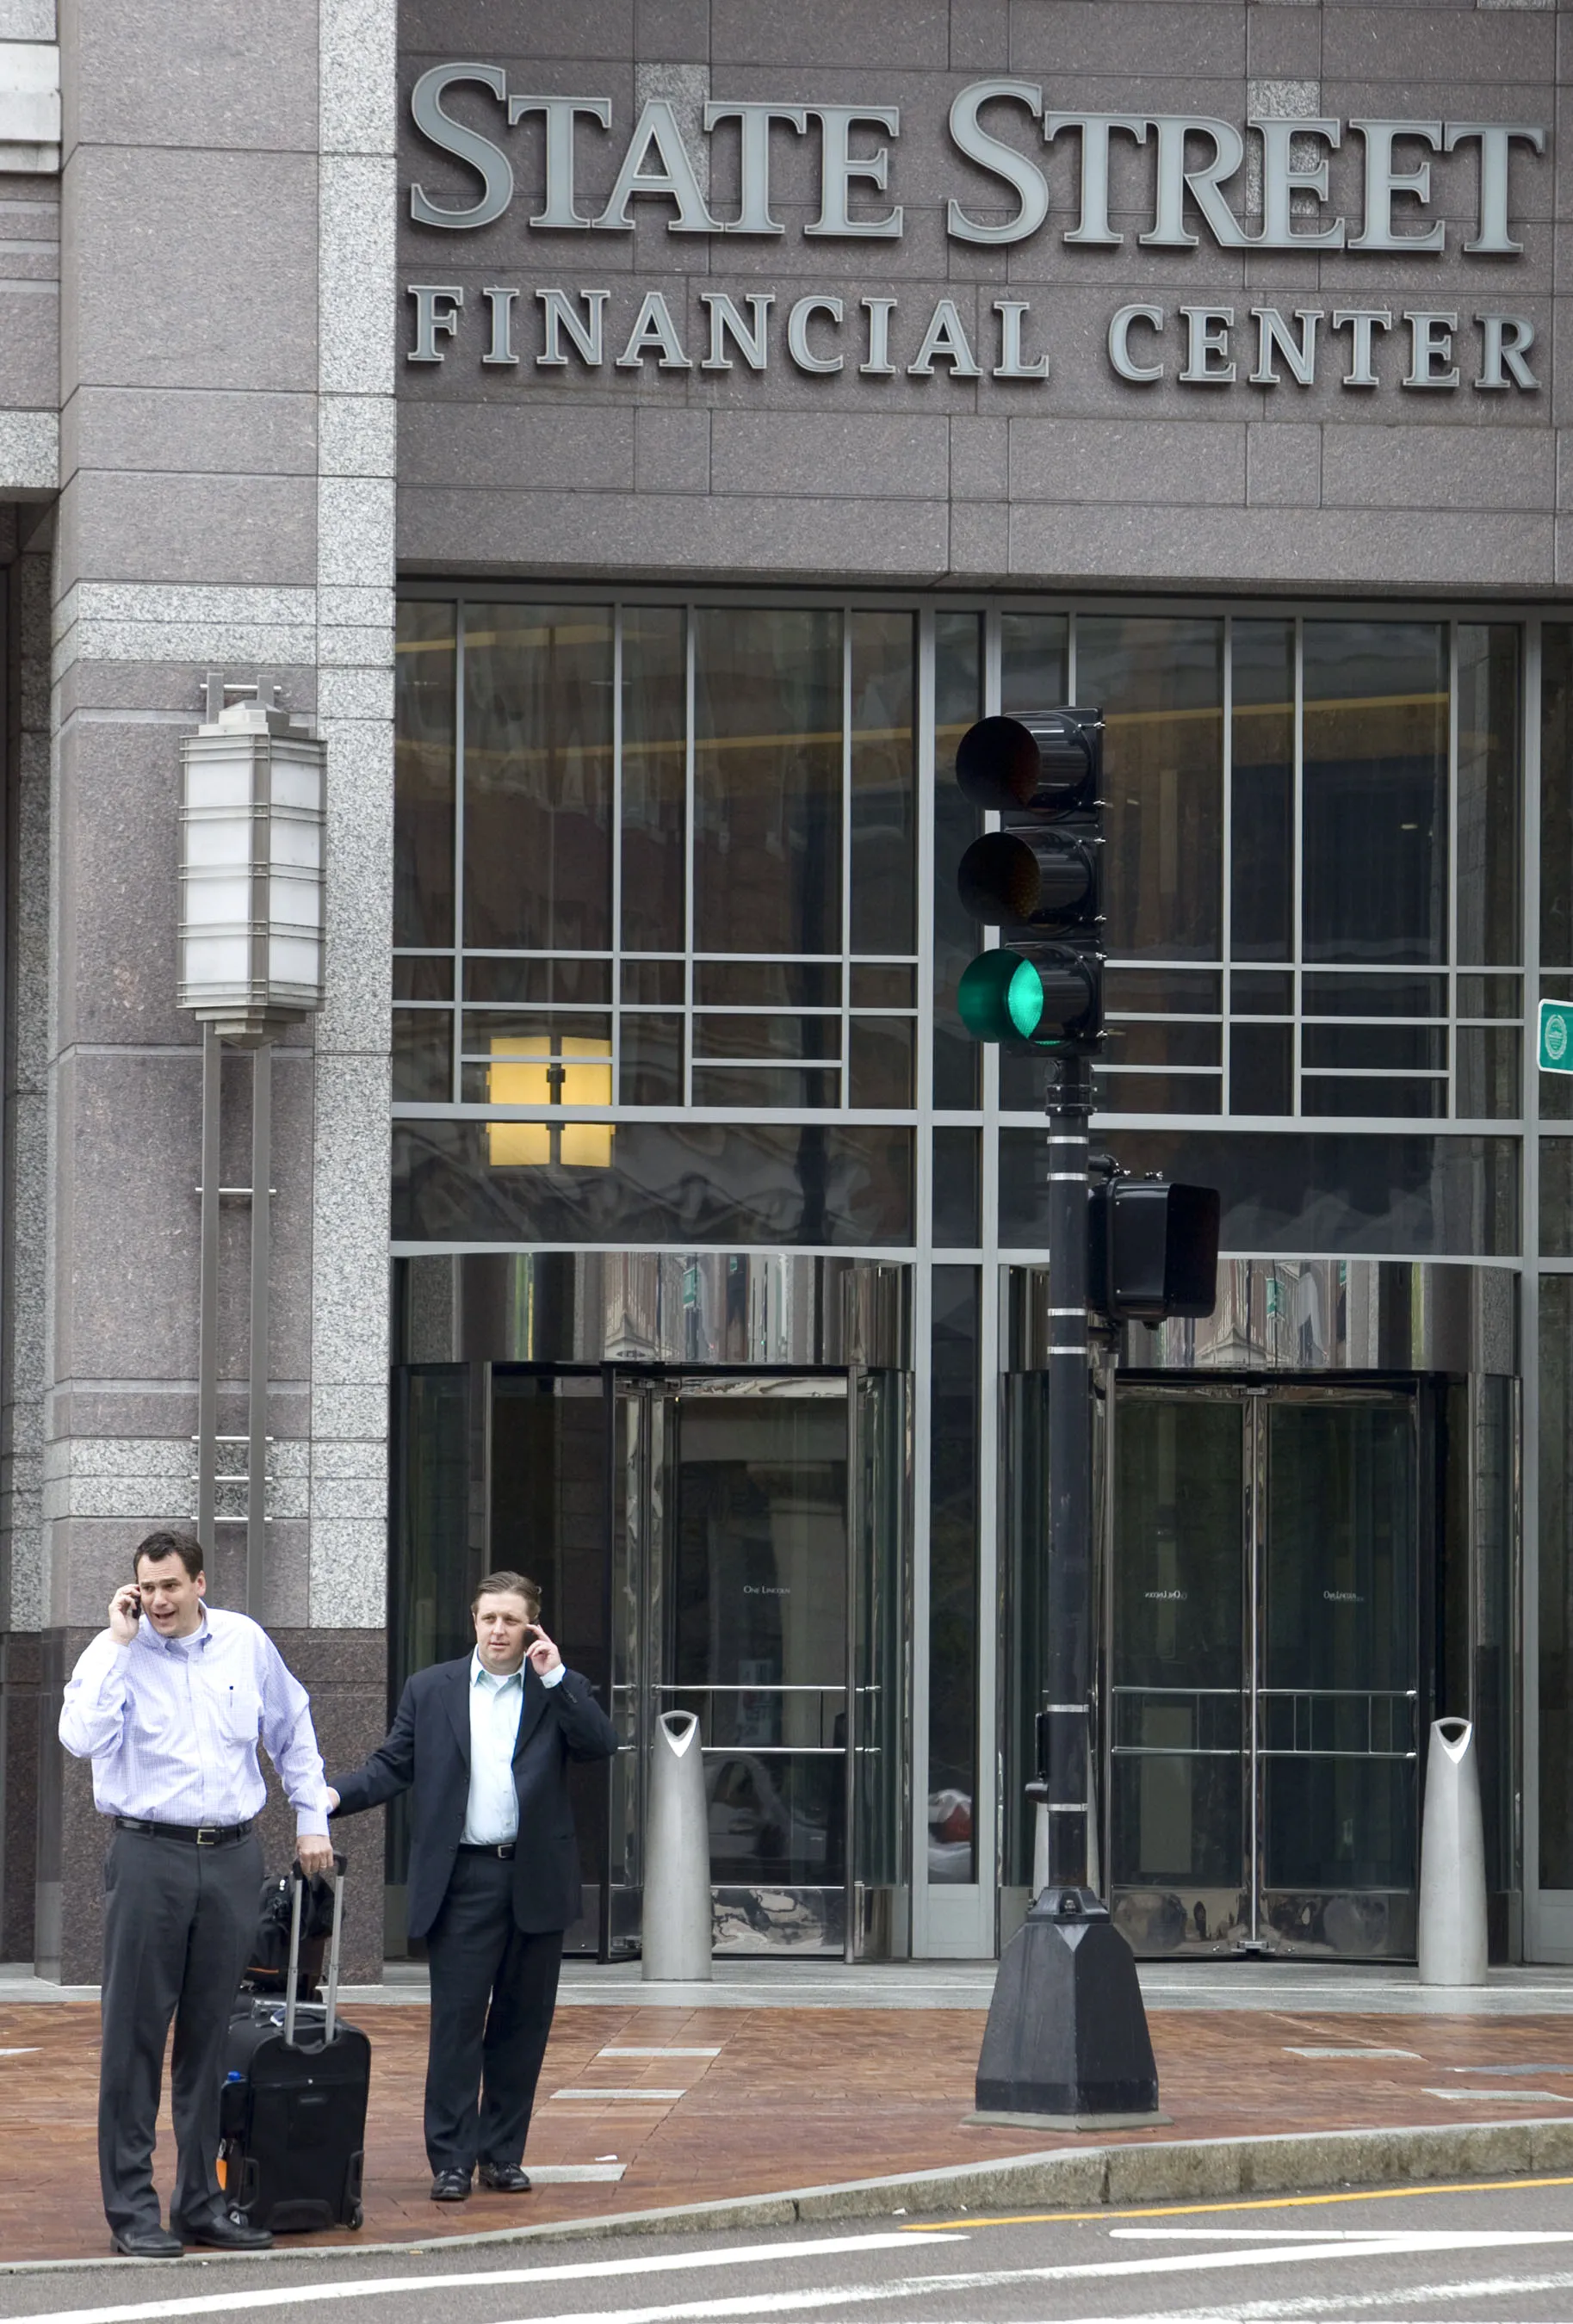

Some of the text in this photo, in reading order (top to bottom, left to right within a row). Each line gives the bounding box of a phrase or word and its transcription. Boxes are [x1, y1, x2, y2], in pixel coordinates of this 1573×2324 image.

[411, 62, 1545, 253] STATE STREET
[407, 285, 1542, 390] FINANCIAL CENTER
